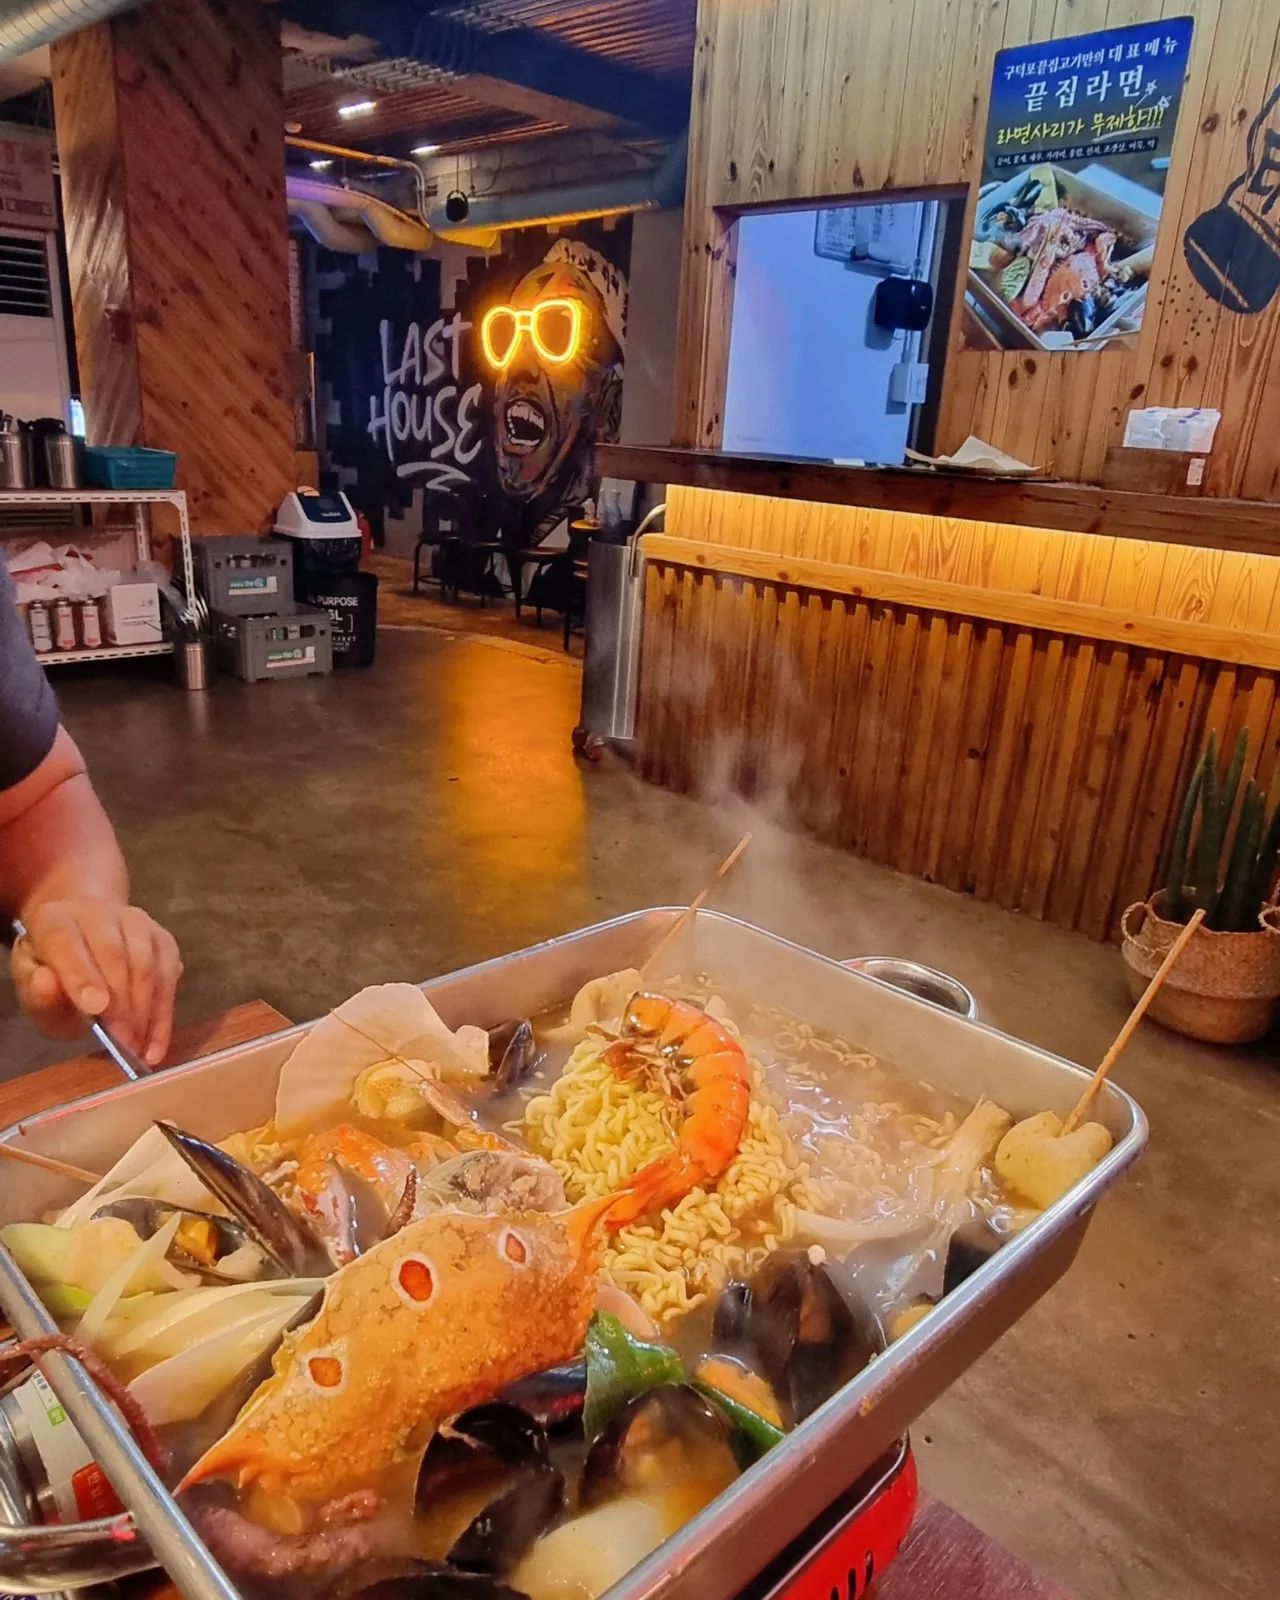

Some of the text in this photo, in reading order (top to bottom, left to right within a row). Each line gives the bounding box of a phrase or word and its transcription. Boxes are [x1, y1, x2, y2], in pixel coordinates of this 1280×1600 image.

[997, 117, 1086, 145] 라면사리가
[380, 312, 472, 386] LAST
[367, 382, 482, 465] HOUSE
